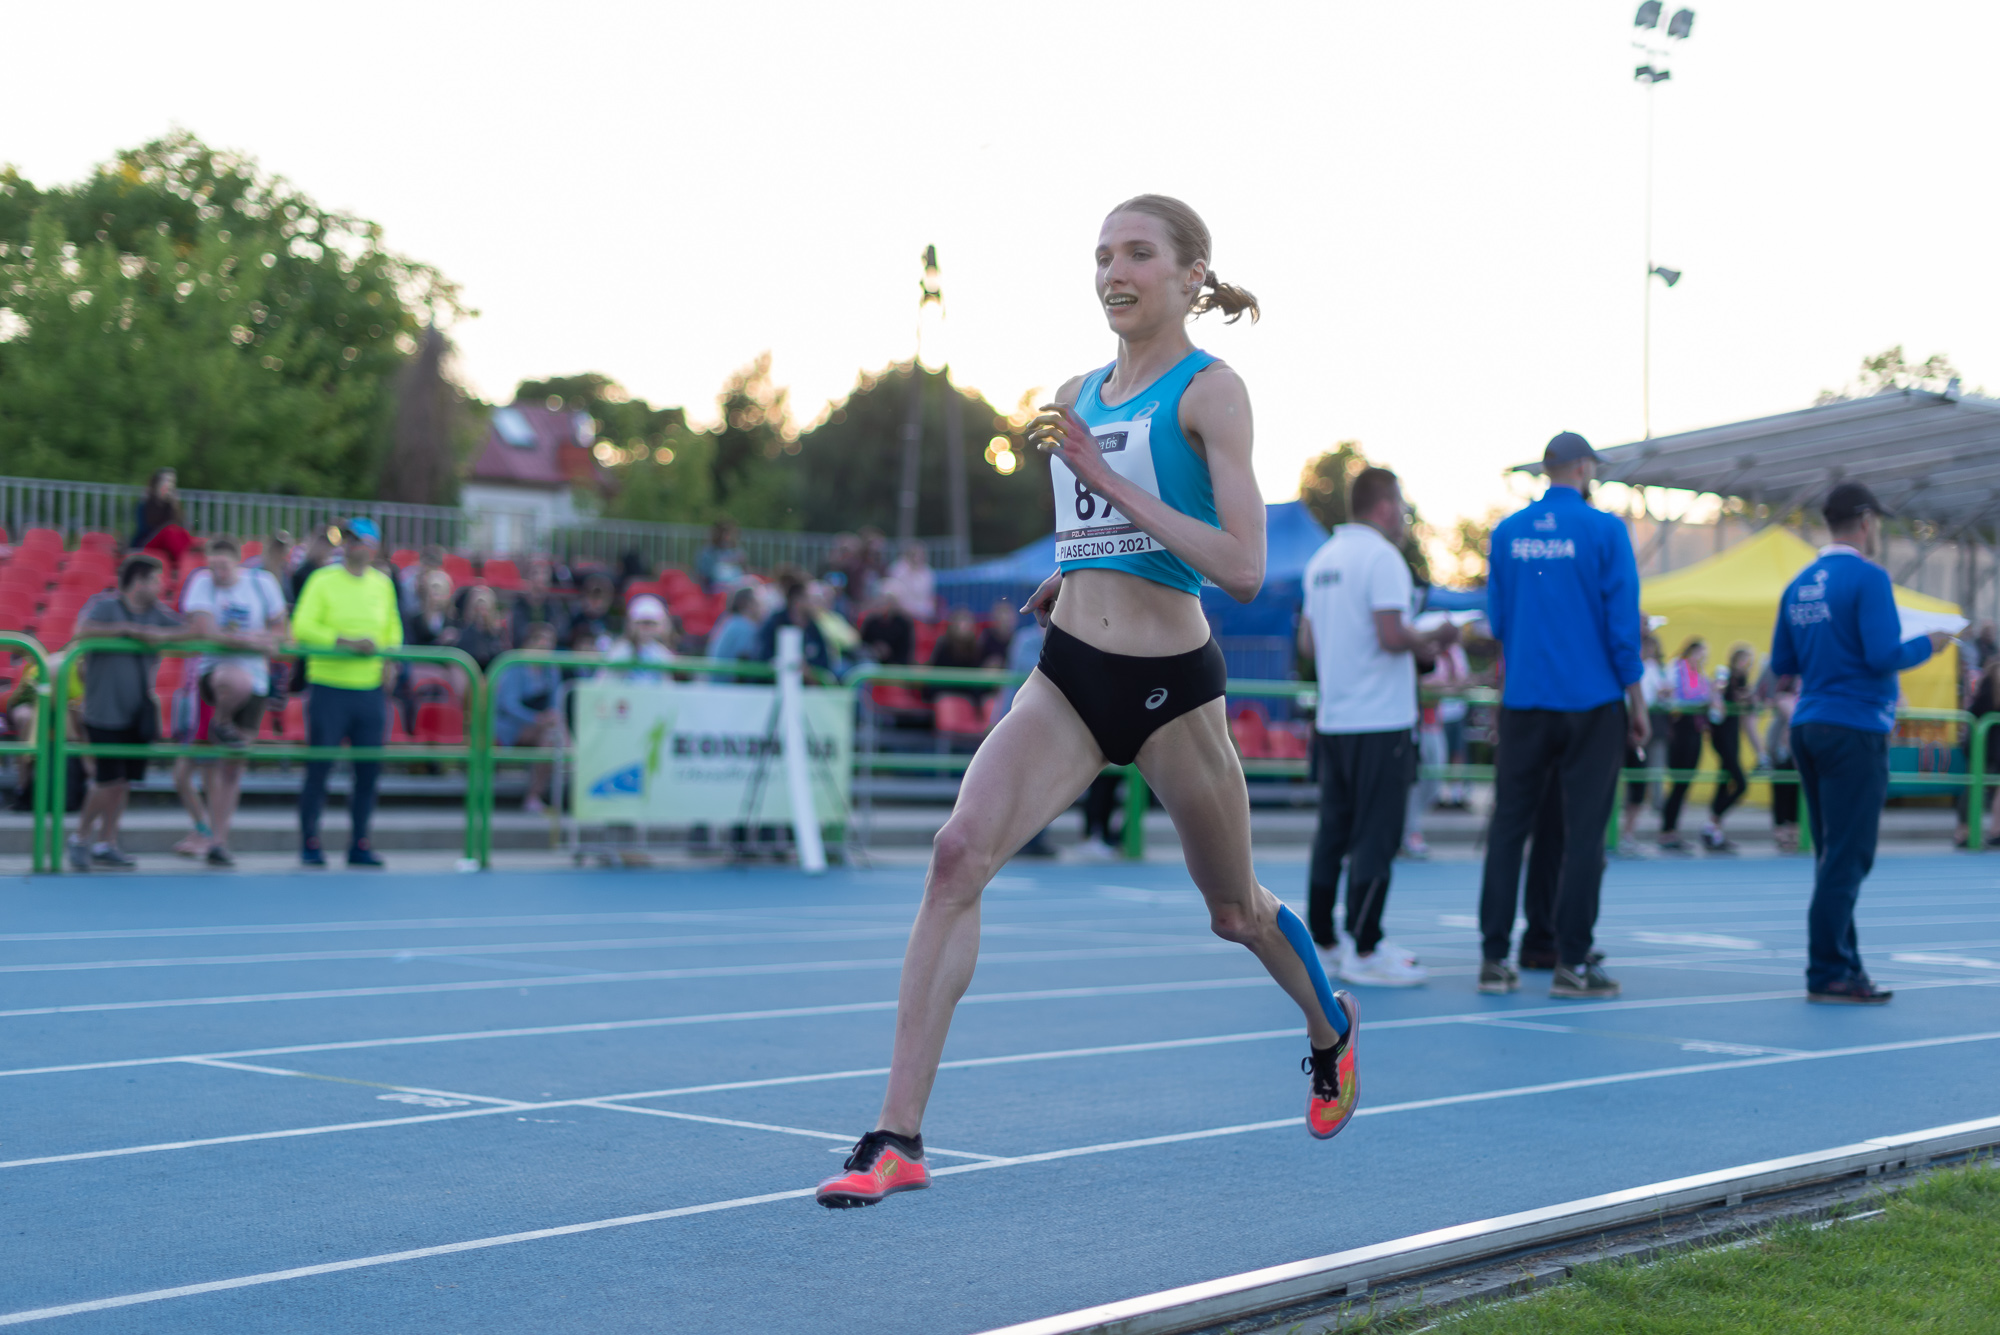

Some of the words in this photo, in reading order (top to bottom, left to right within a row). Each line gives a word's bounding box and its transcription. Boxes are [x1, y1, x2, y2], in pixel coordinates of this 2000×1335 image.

[1071, 530, 1086, 538] PZLA
[1060, 541, 1115, 559] PIASECZNO
[1118, 536, 1152, 553] 2021
